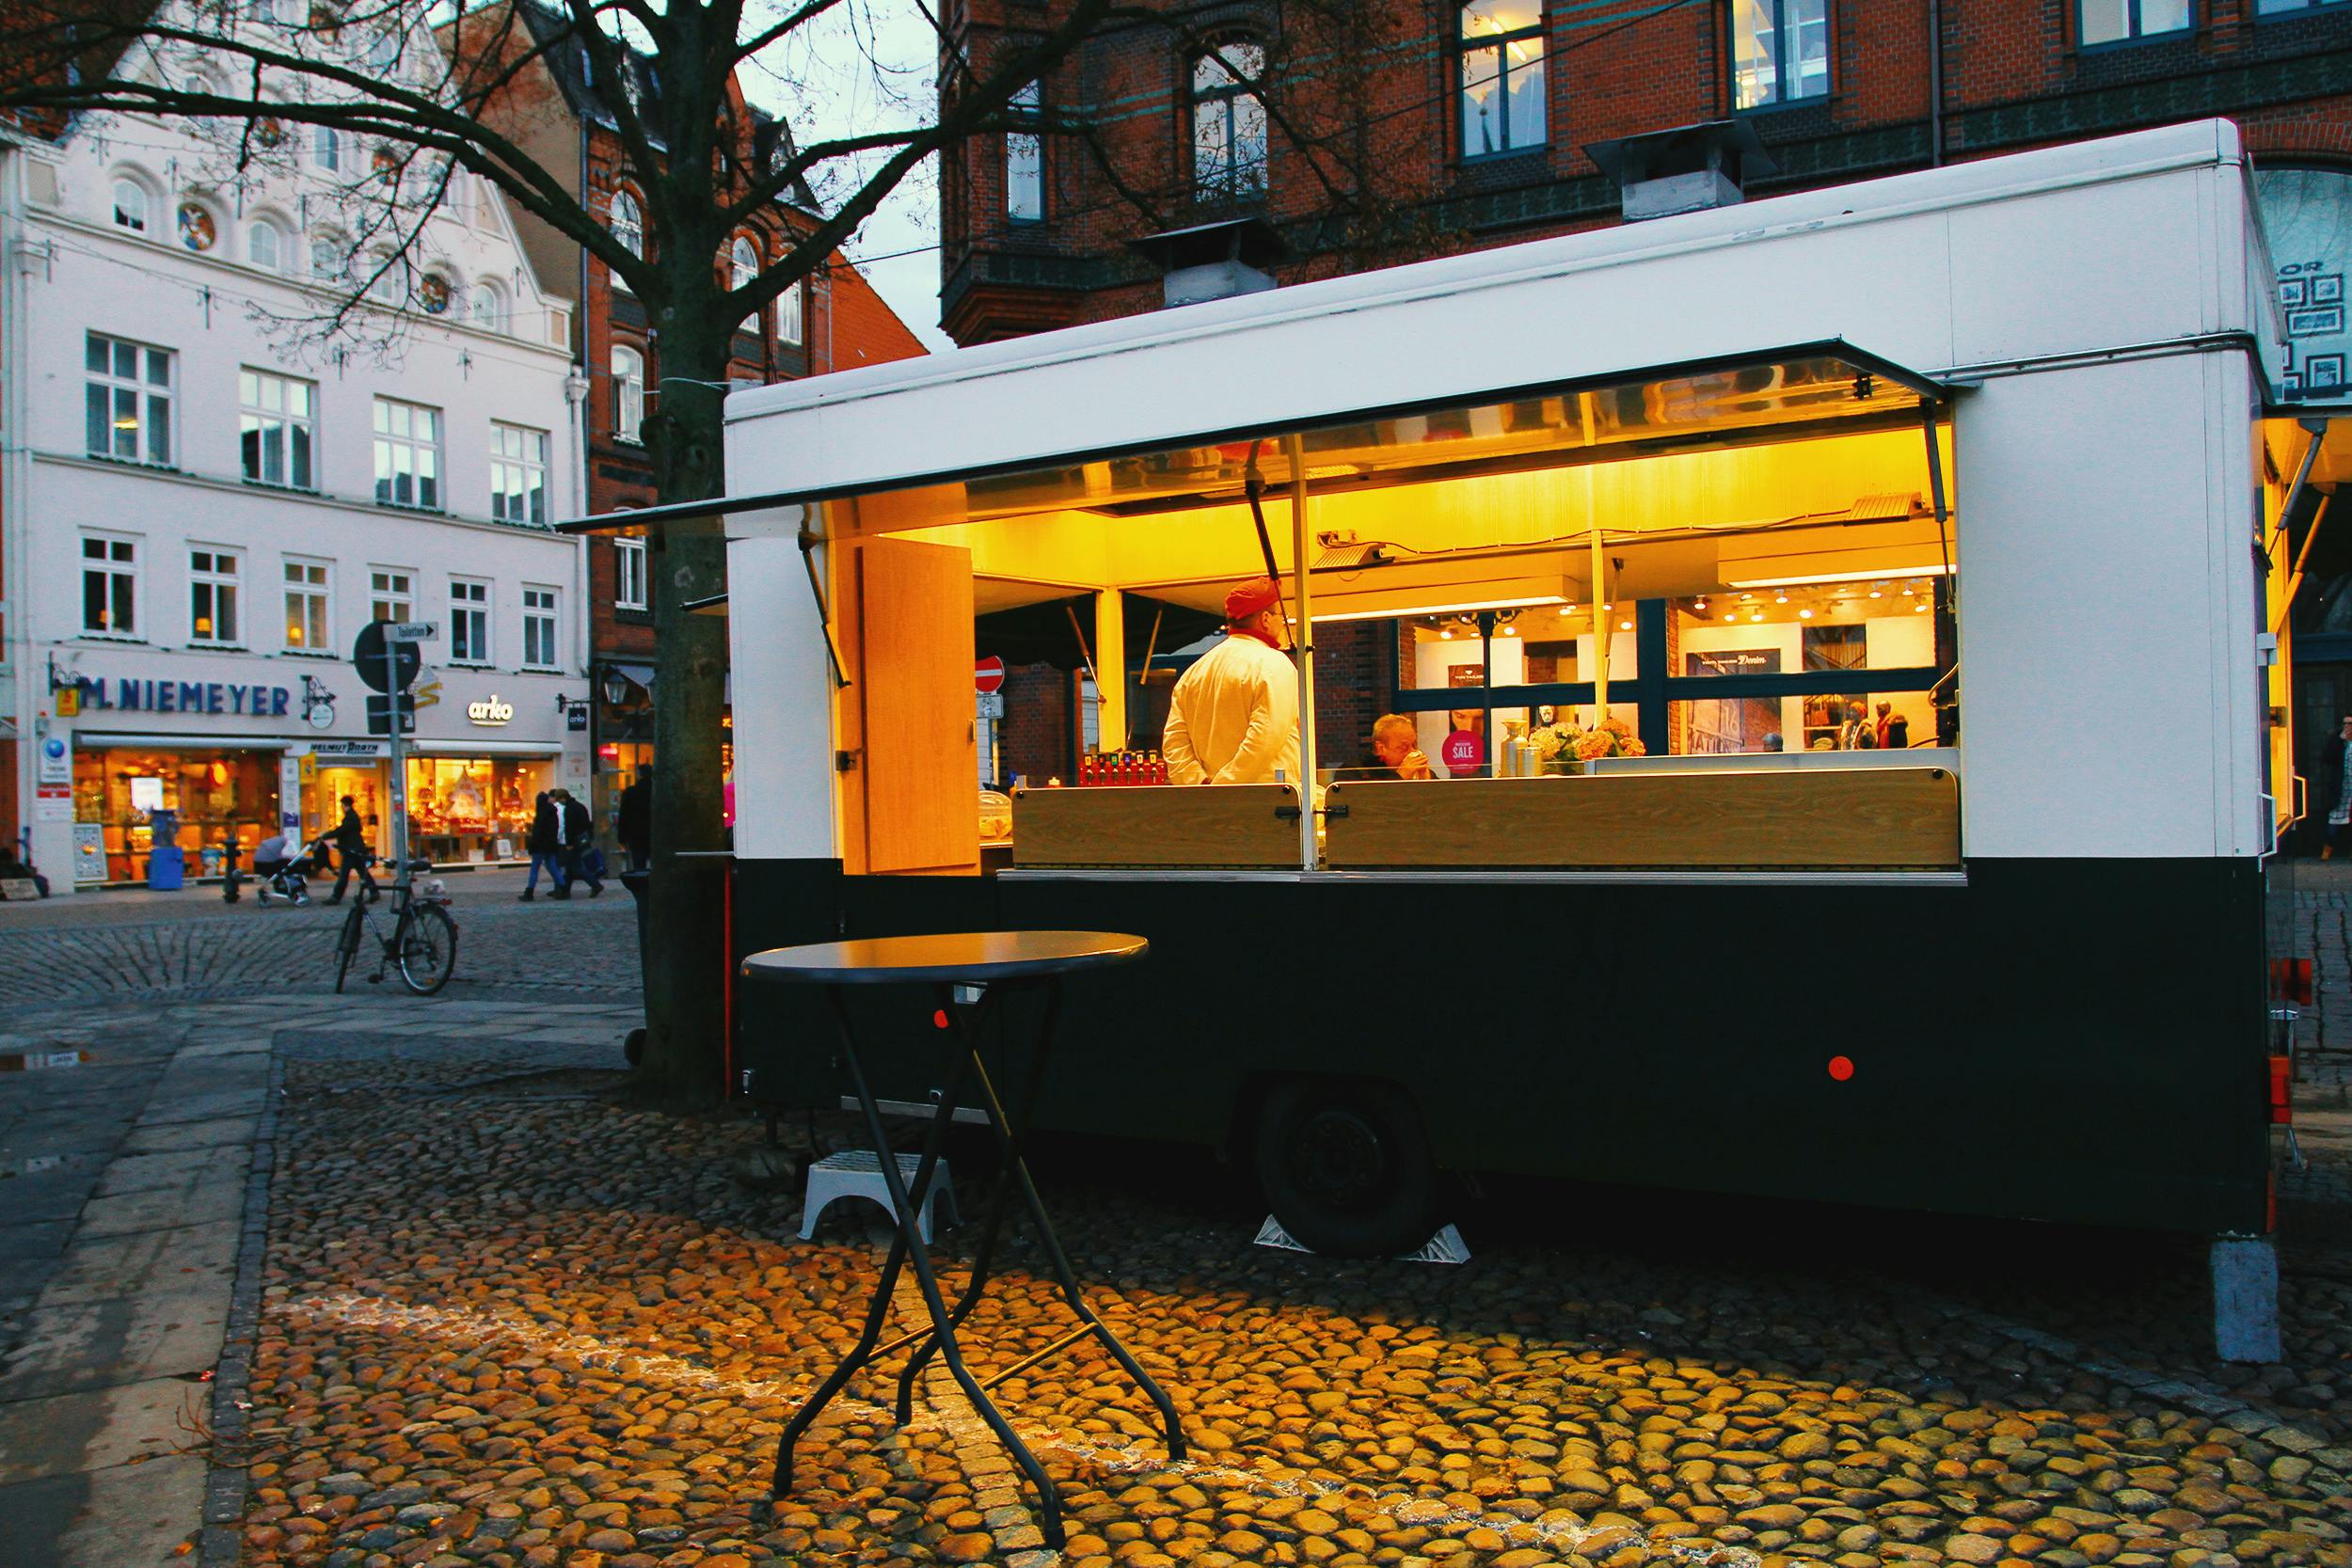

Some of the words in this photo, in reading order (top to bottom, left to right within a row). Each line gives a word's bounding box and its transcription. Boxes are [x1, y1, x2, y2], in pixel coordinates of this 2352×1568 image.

[397, 626, 424, 638] Toiletten
[468, 694, 514, 721] arko
[569, 714, 585, 723] arko
[1452, 746, 1473, 759] SALE
